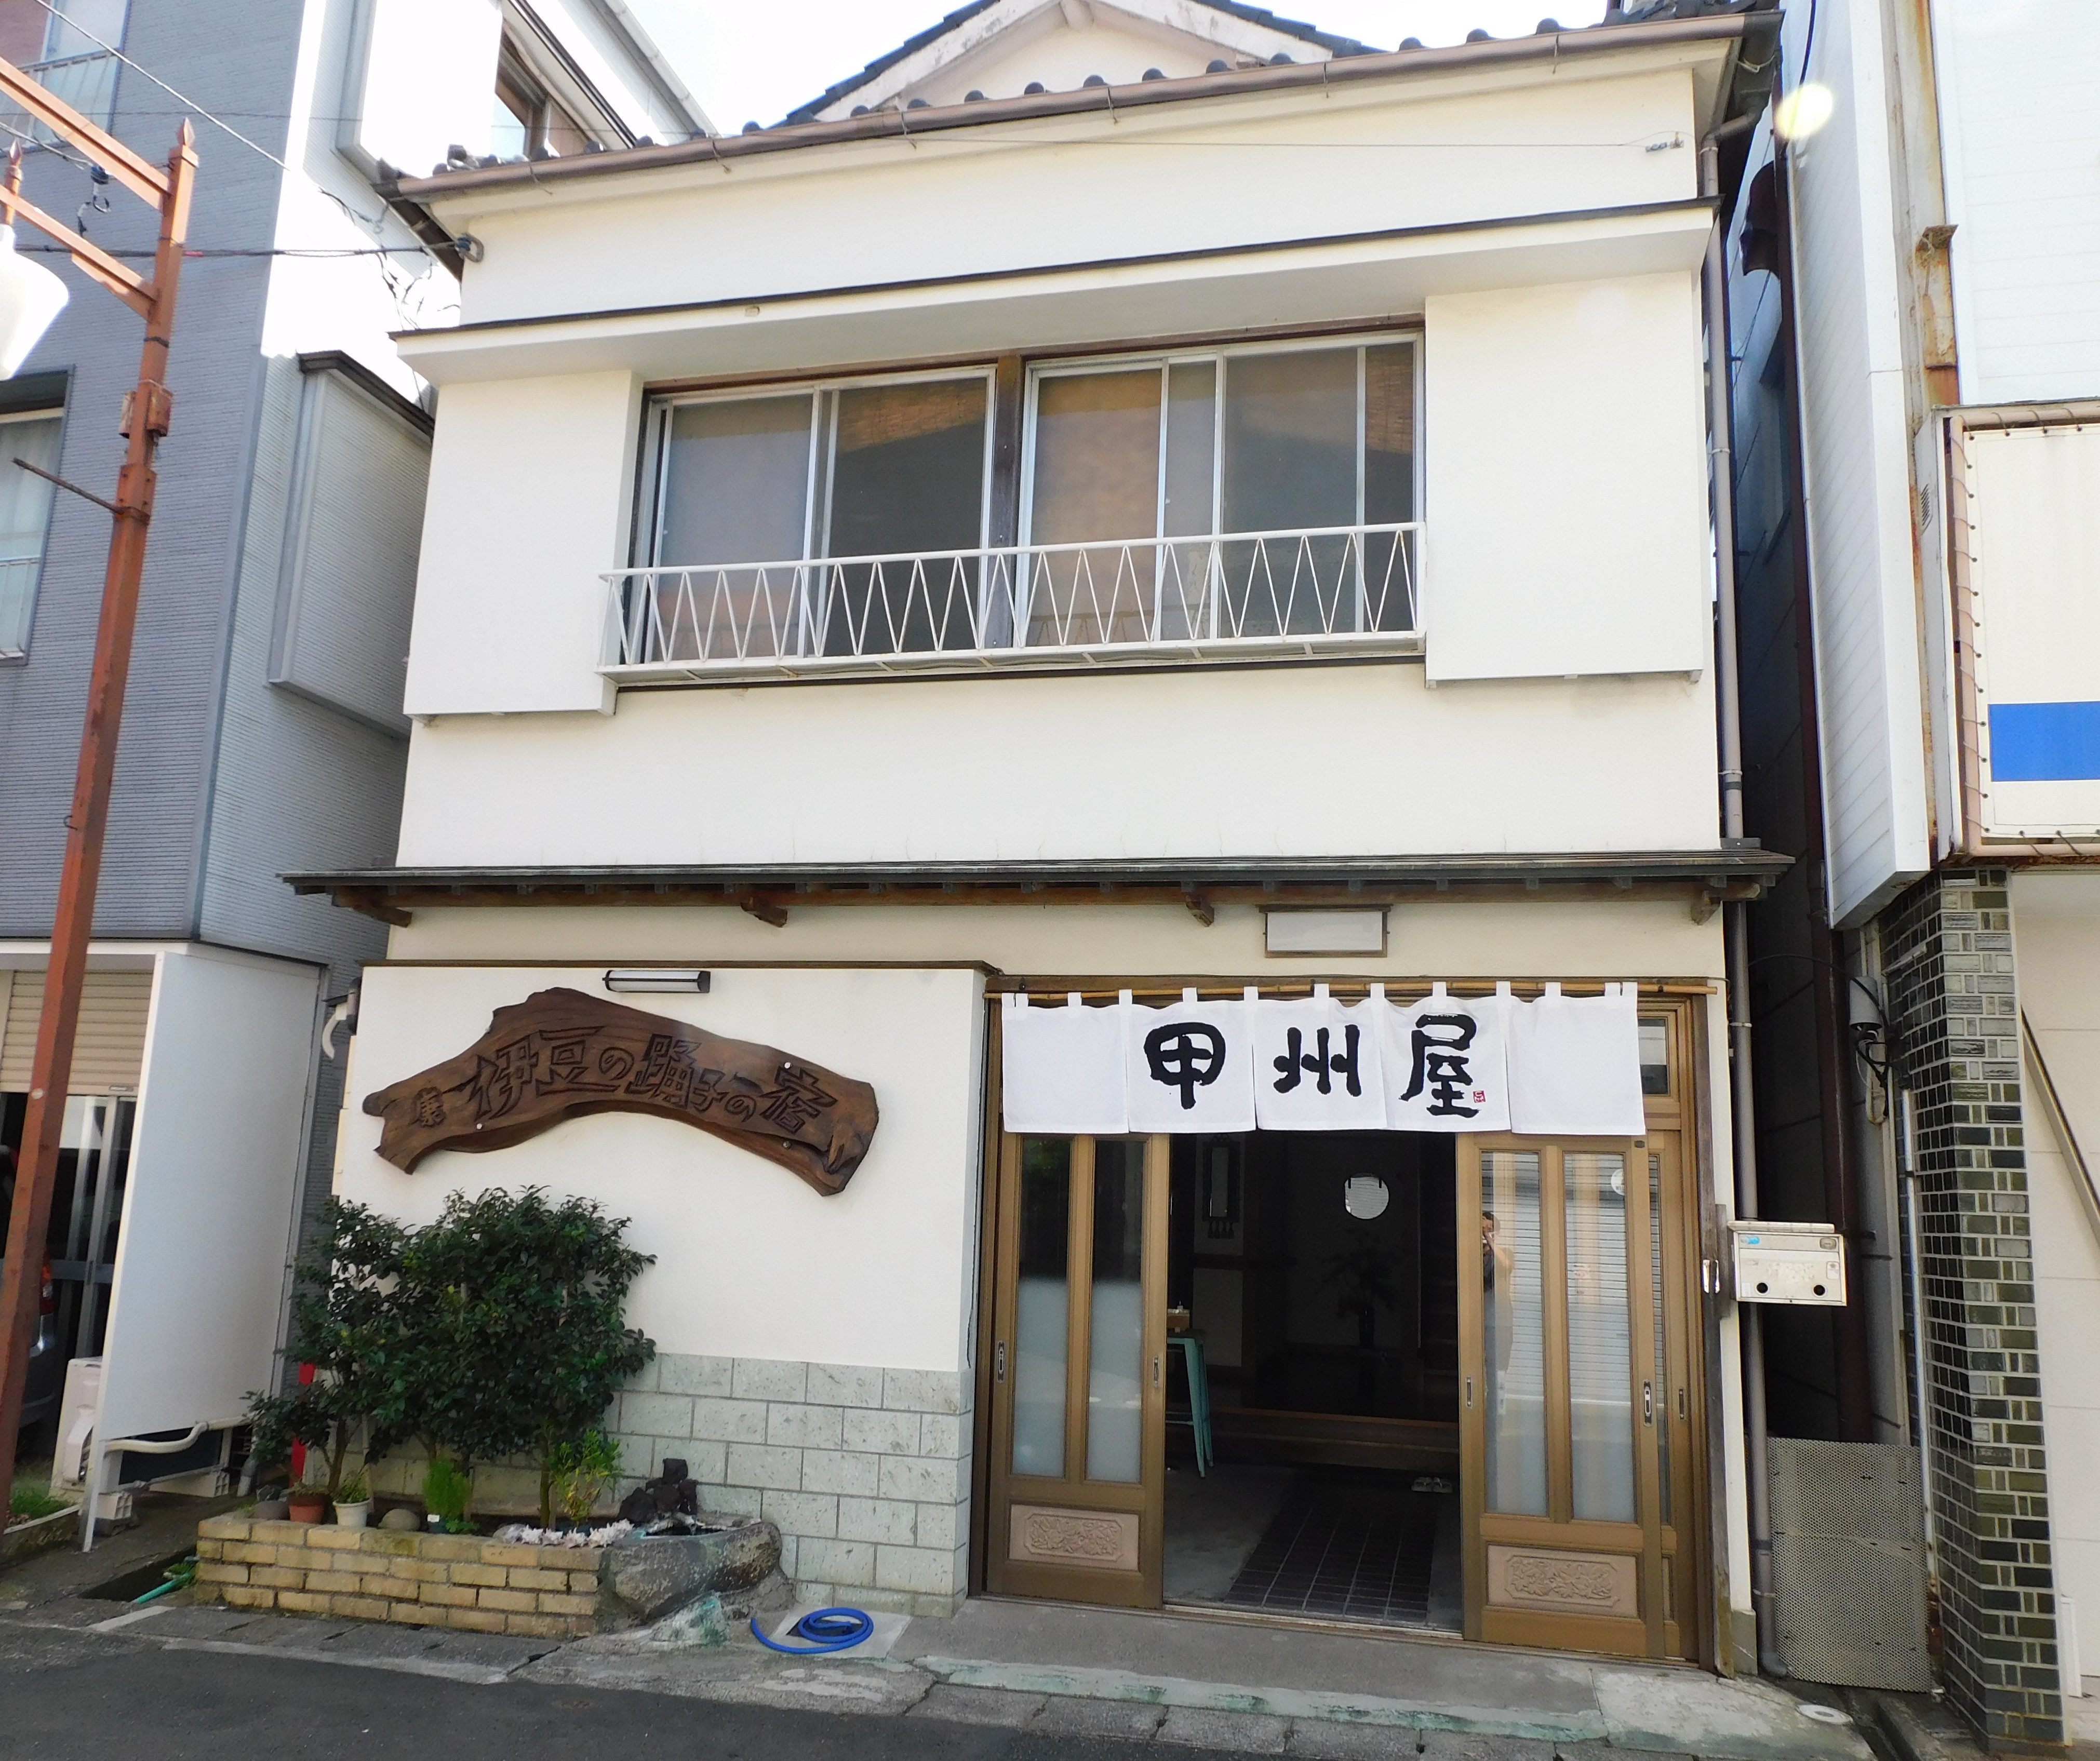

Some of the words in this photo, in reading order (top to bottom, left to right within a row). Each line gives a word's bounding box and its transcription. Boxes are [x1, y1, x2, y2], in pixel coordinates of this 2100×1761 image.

[469, 1025, 837, 1134] 伊豆の踊子の宿
[1144, 1014, 1479, 1118] 甲州屋
